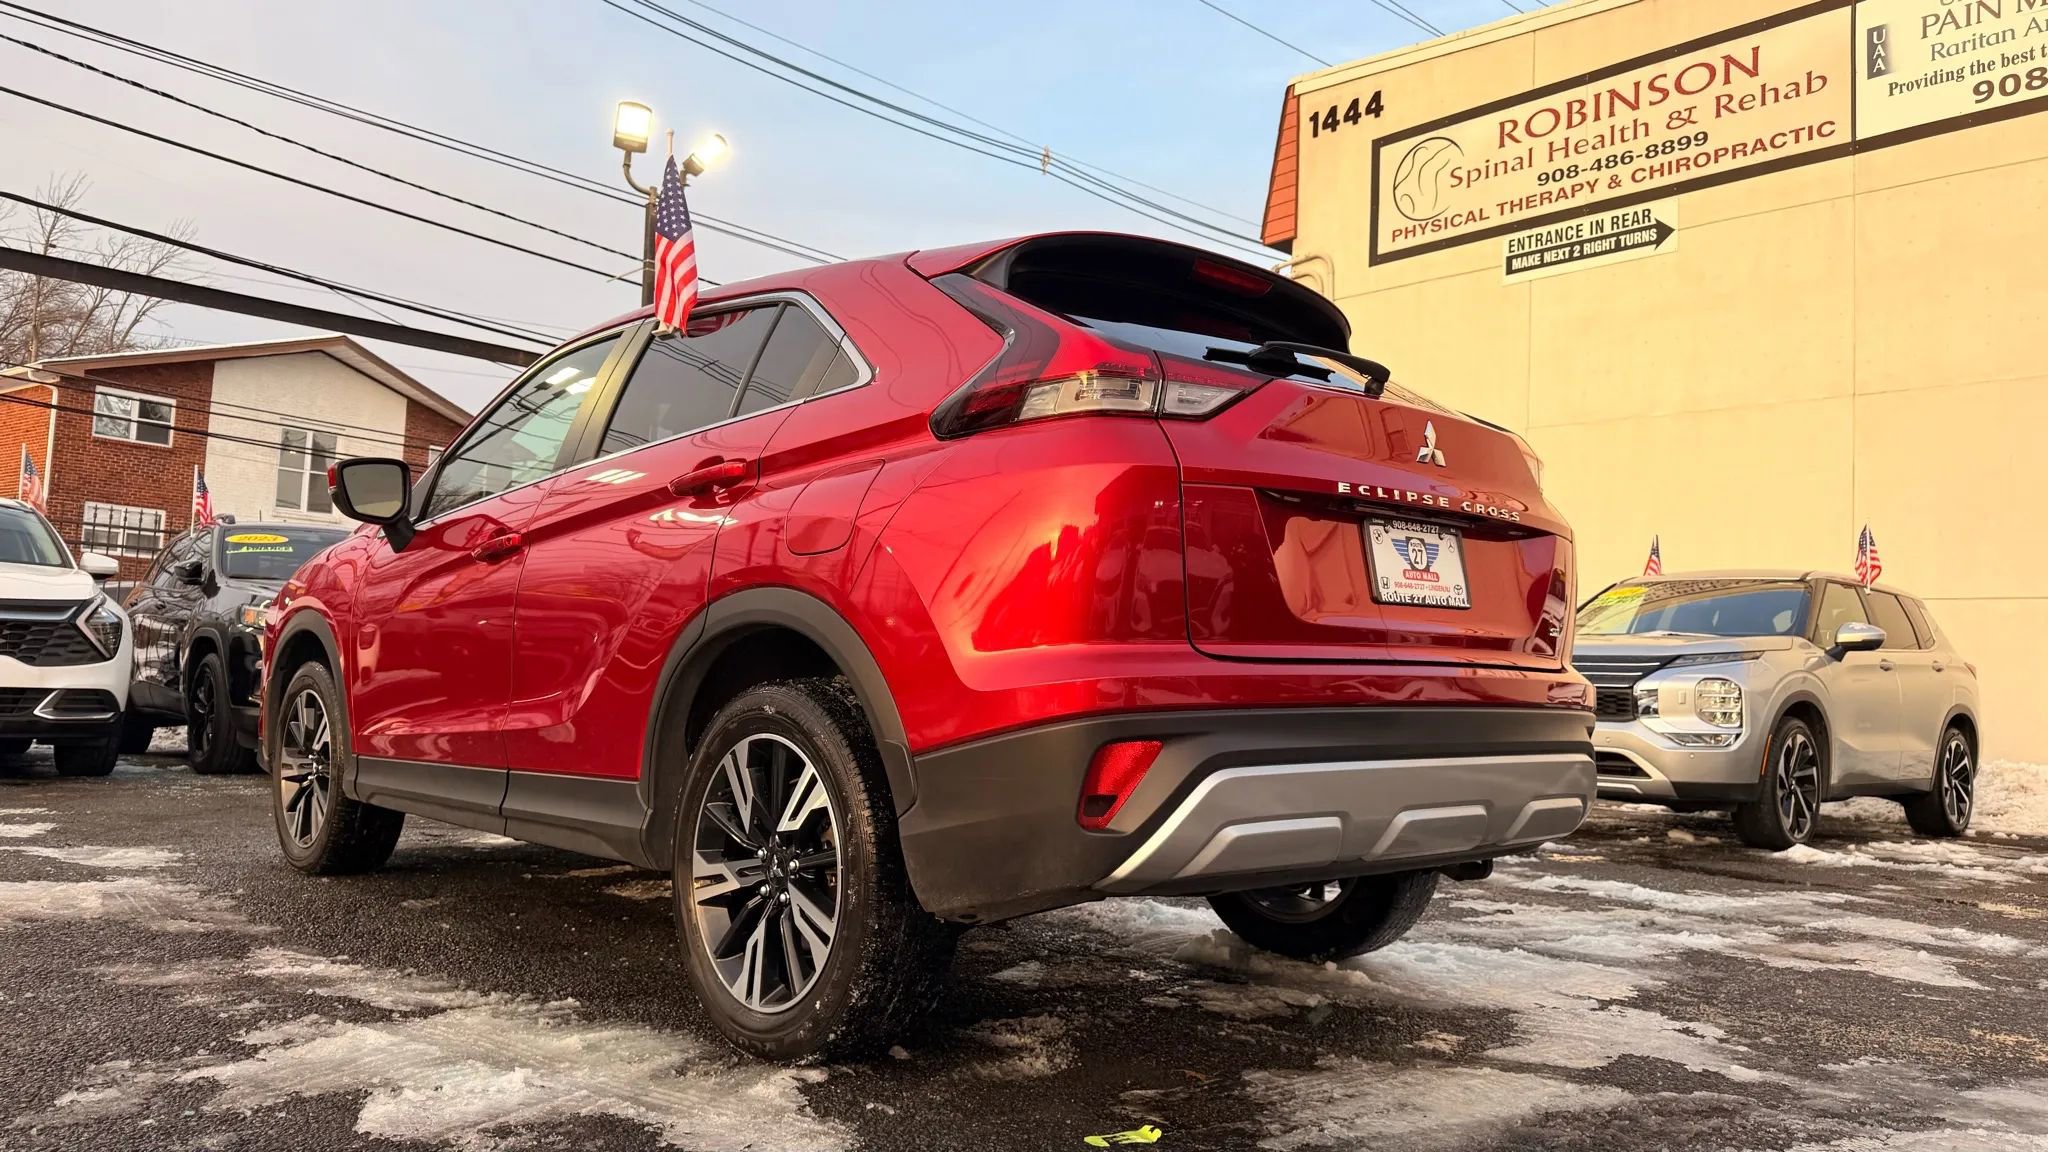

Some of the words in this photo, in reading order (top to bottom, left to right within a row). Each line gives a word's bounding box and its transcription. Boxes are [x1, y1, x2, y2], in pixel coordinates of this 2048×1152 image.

[1921, 0, 2001, 39] PAIN
[1873, 28, 1887, 73] UAA
[1931, 28, 2016, 61] Raritan
[1888, 66, 1966, 97] Providing
[1969, 59, 1996, 76] the
[2001, 46, 2036, 69] best
[1309, 90, 1384, 138] 1444
[1498, 46, 1760, 149] ROBINSON
[1450, 147, 1533, 188] Spinal
[1548, 118, 1650, 162] Health
[1666, 106, 1698, 130] &
[1715, 70, 1828, 119] Rehab
[1537, 131, 1708, 186] 908-486-8899
[1391, 208, 1490, 242] PHYSICAL
[1496, 178, 1600, 216] THERAPY
[1607, 174, 1622, 189] &
[1631, 121, 1836, 183] CHIROPRACTIC
[1508, 224, 1583, 253] ENTRANCE
[1590, 218, 1604, 235] IN
[1611, 208, 1651, 231] REAR
[1511, 255, 1541, 270] MAKE
[1543, 247, 1571, 263] NEXT
[1573, 245, 1580, 257] 2
[1583, 237, 1617, 255] RIGHT
[1619, 229, 1657, 247] TURNS
[1338, 482, 1449, 507] ECLIPSE
[1460, 501, 1521, 522] CROSS
[1392, 521, 1439, 533] 908-648-2727
[1405, 570, 1421, 579] AUTO
[1422, 572, 1438, 581] MALL
[1412, 548, 1423, 565] 27
[1382, 592, 1412, 602] ROUTE
[1412, 594, 1423, 603] 27
[1425, 594, 1446, 605] AUTO
[1448, 596, 1470, 607] MALL
